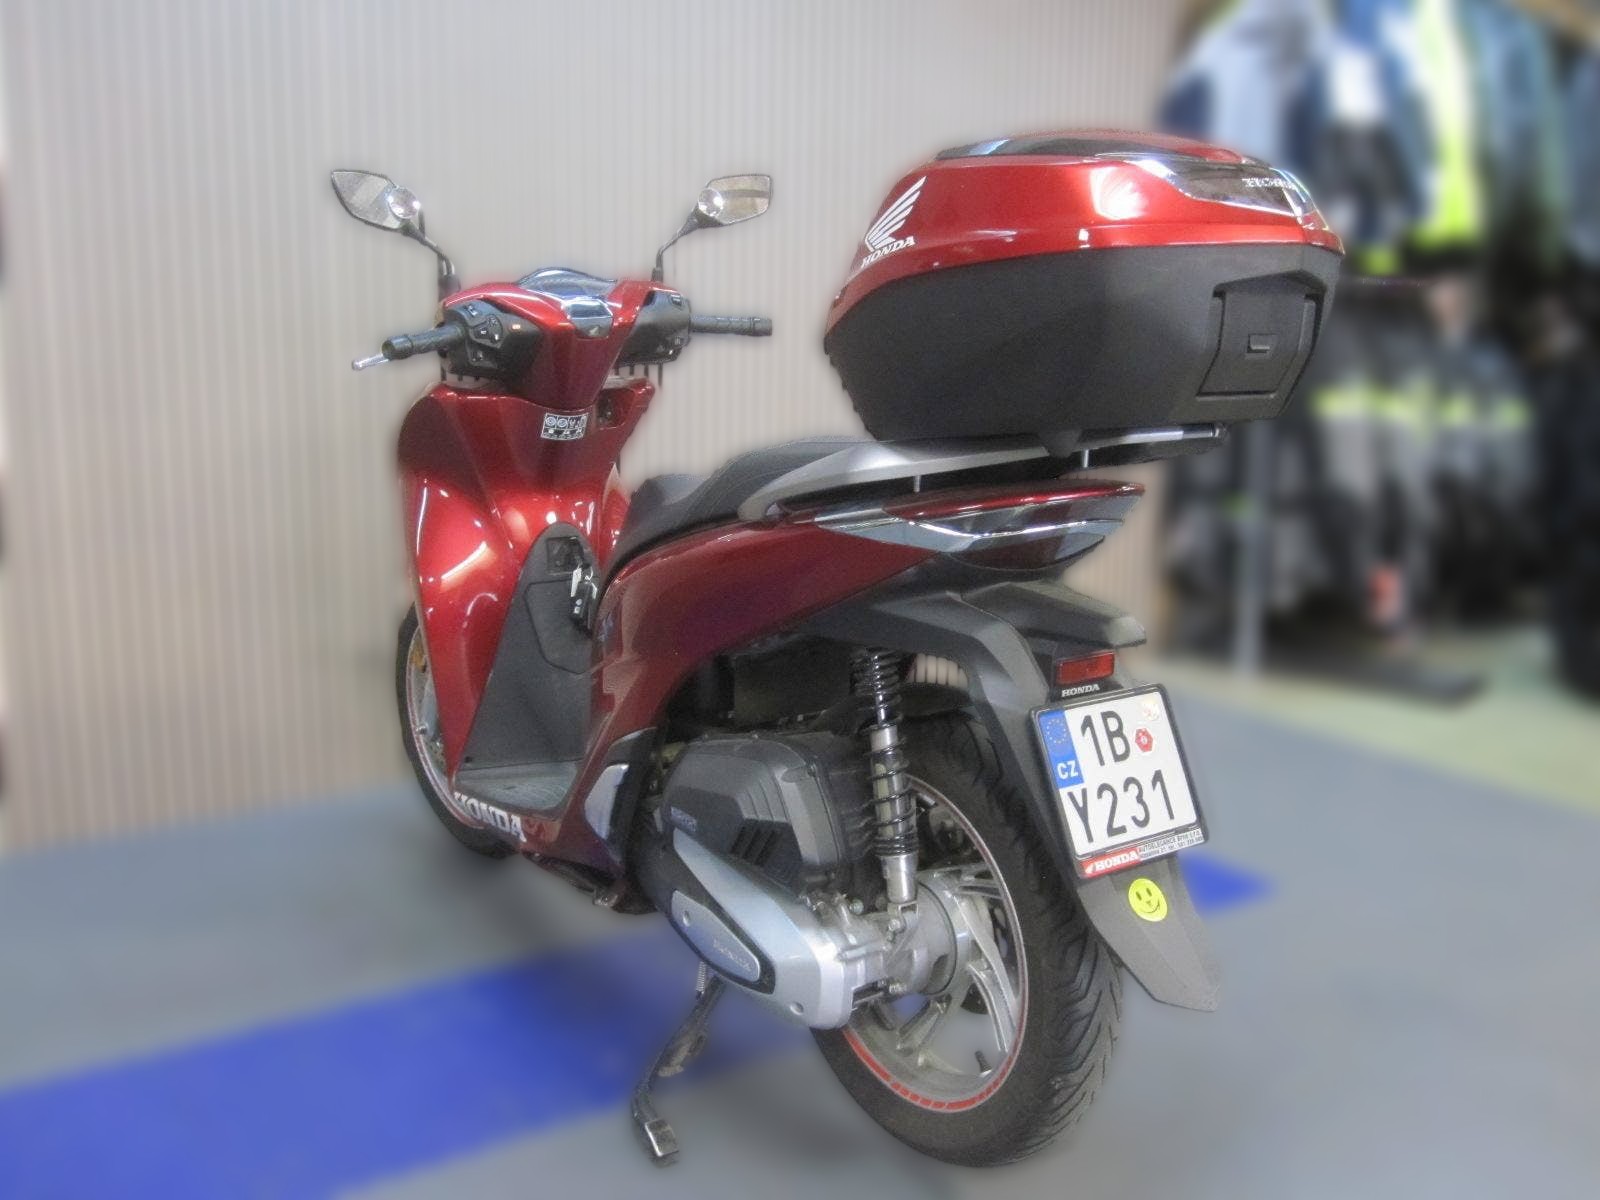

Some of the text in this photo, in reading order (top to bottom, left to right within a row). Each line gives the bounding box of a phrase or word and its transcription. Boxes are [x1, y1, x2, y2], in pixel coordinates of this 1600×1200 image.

[860, 235, 916, 269] HONDA
[1061, 683, 1100, 698] HONDA
[1080, 710, 1131, 767] 1B
[1057, 760, 1079, 780] CZ
[1067, 769, 1175, 844] Y231
[1094, 850, 1139, 871] HONDA
